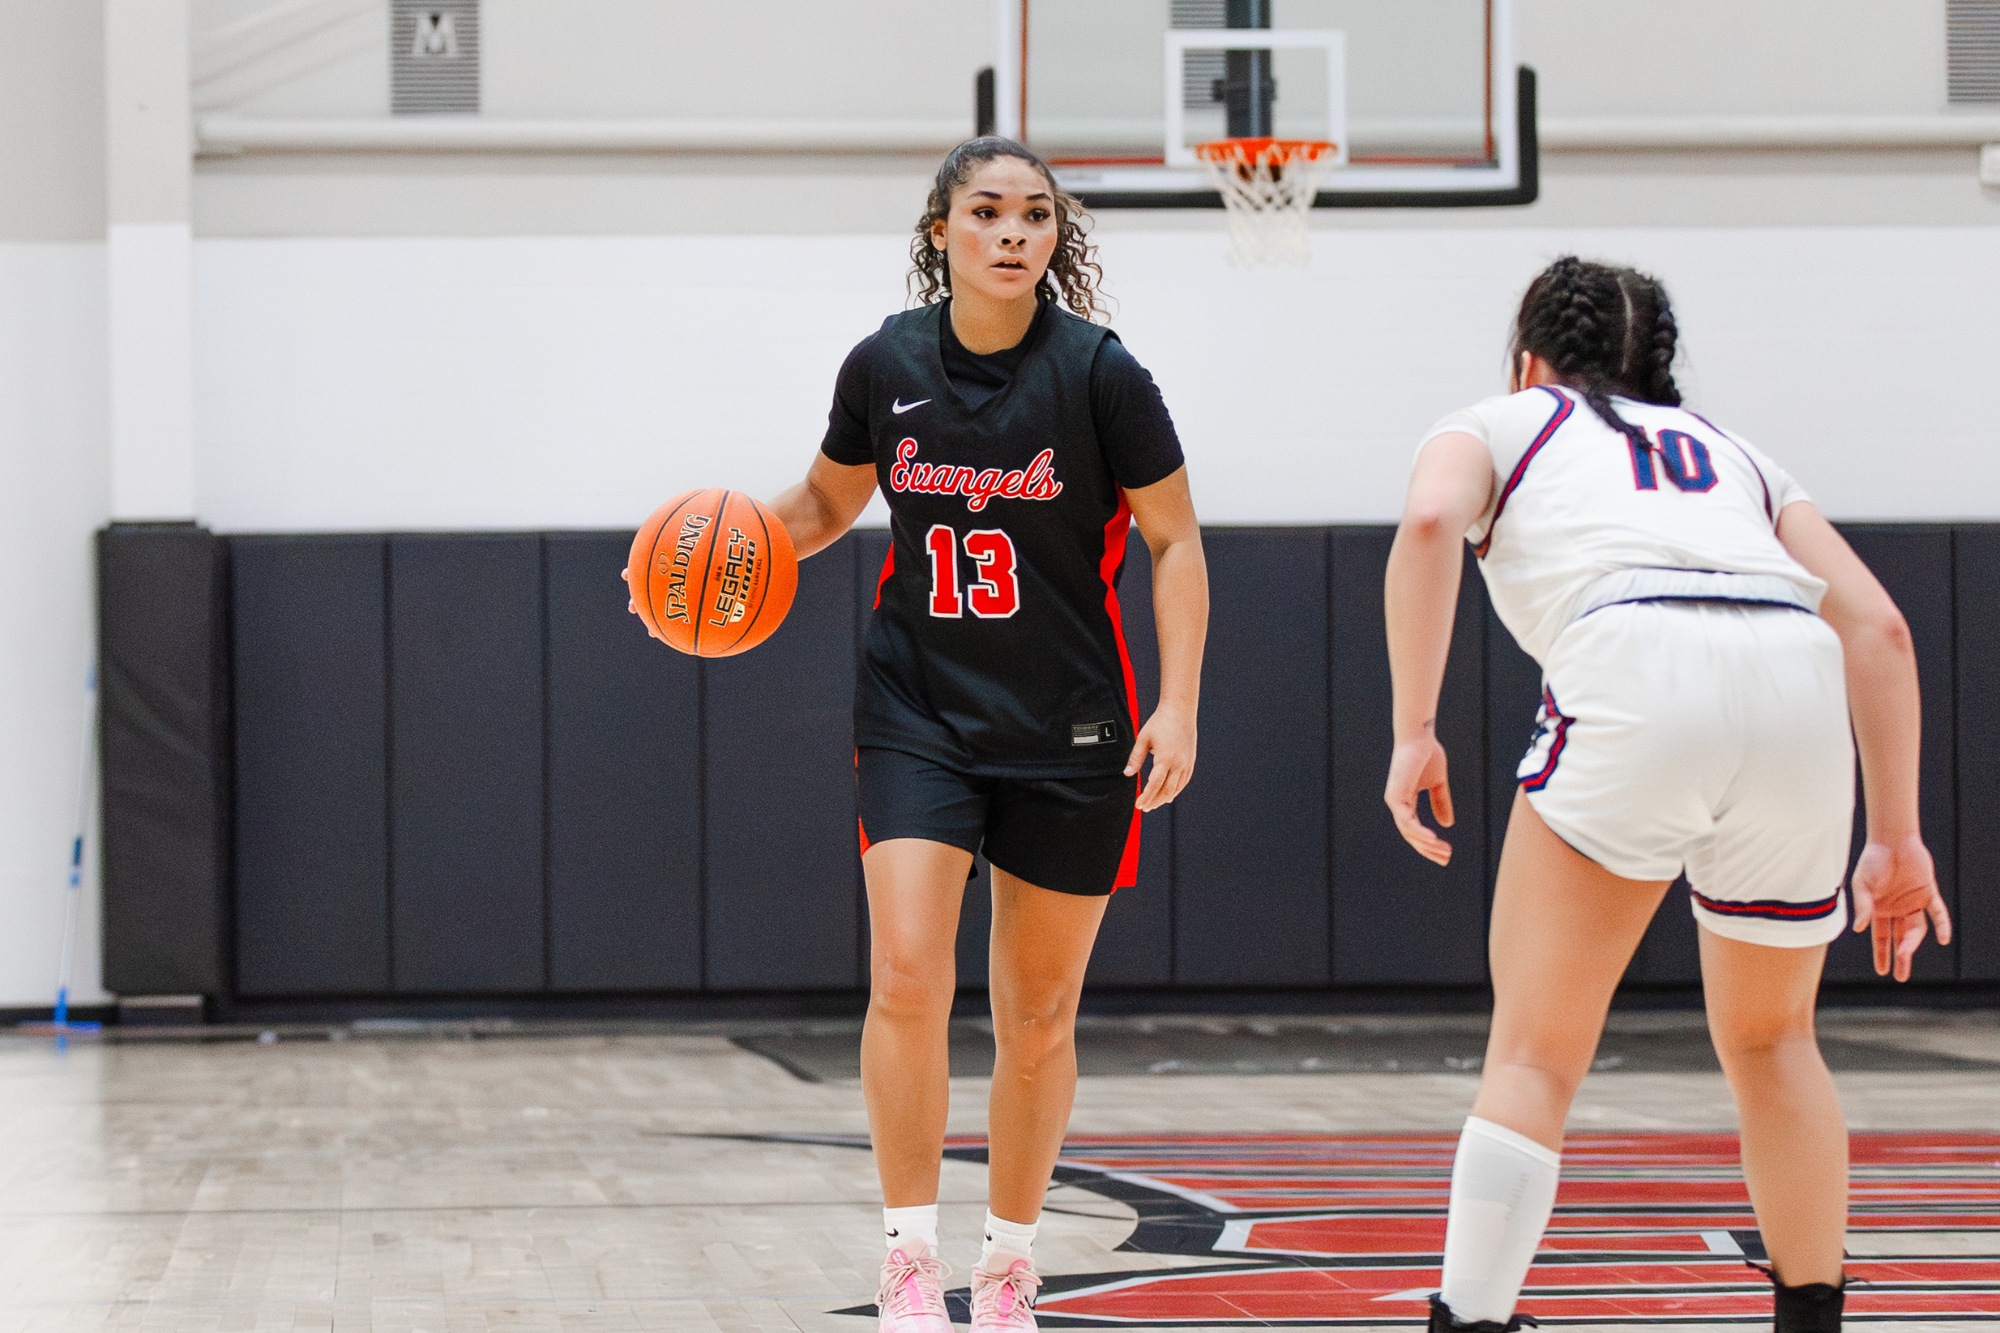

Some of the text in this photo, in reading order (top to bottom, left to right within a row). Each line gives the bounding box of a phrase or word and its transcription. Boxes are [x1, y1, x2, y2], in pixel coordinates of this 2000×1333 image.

[890, 437, 1063, 512] Evangels
[1626, 425, 1718, 493] 10
[665, 513, 712, 624] SPALDING
[709, 527, 746, 627] LEGACY
[925, 524, 1020, 618] 13
[1105, 726, 1111, 737] L
